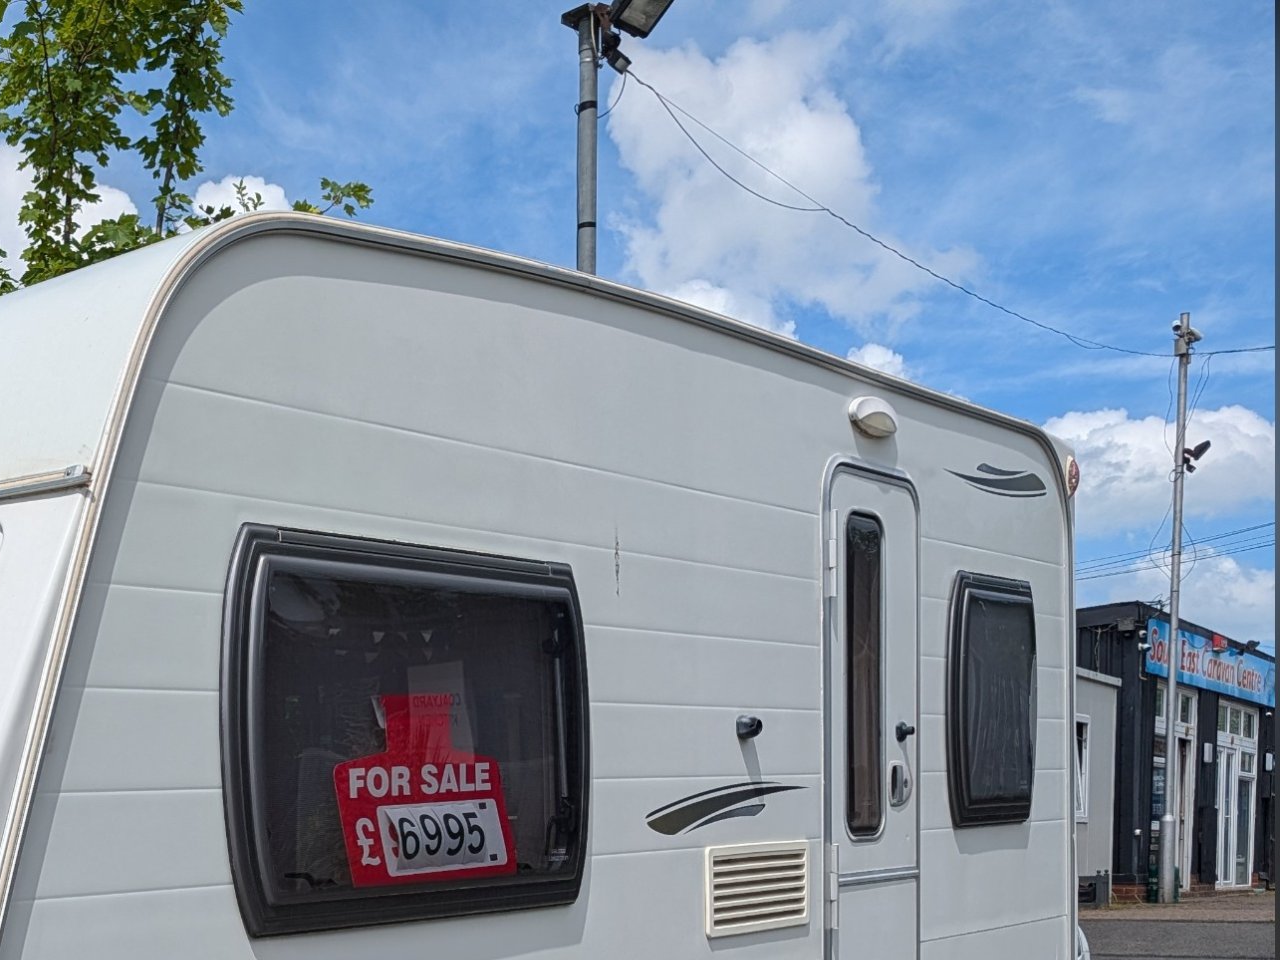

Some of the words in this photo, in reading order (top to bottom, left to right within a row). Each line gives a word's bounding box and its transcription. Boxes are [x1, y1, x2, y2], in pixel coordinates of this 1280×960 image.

[1150, 627, 1169, 666] Sou
[1180, 639, 1200, 674] East
[1202, 647, 1235, 685] Caravan
[1237, 658, 1262, 693] Centre
[349, 766, 411, 799] FOR
[420, 762, 492, 795] SALE
